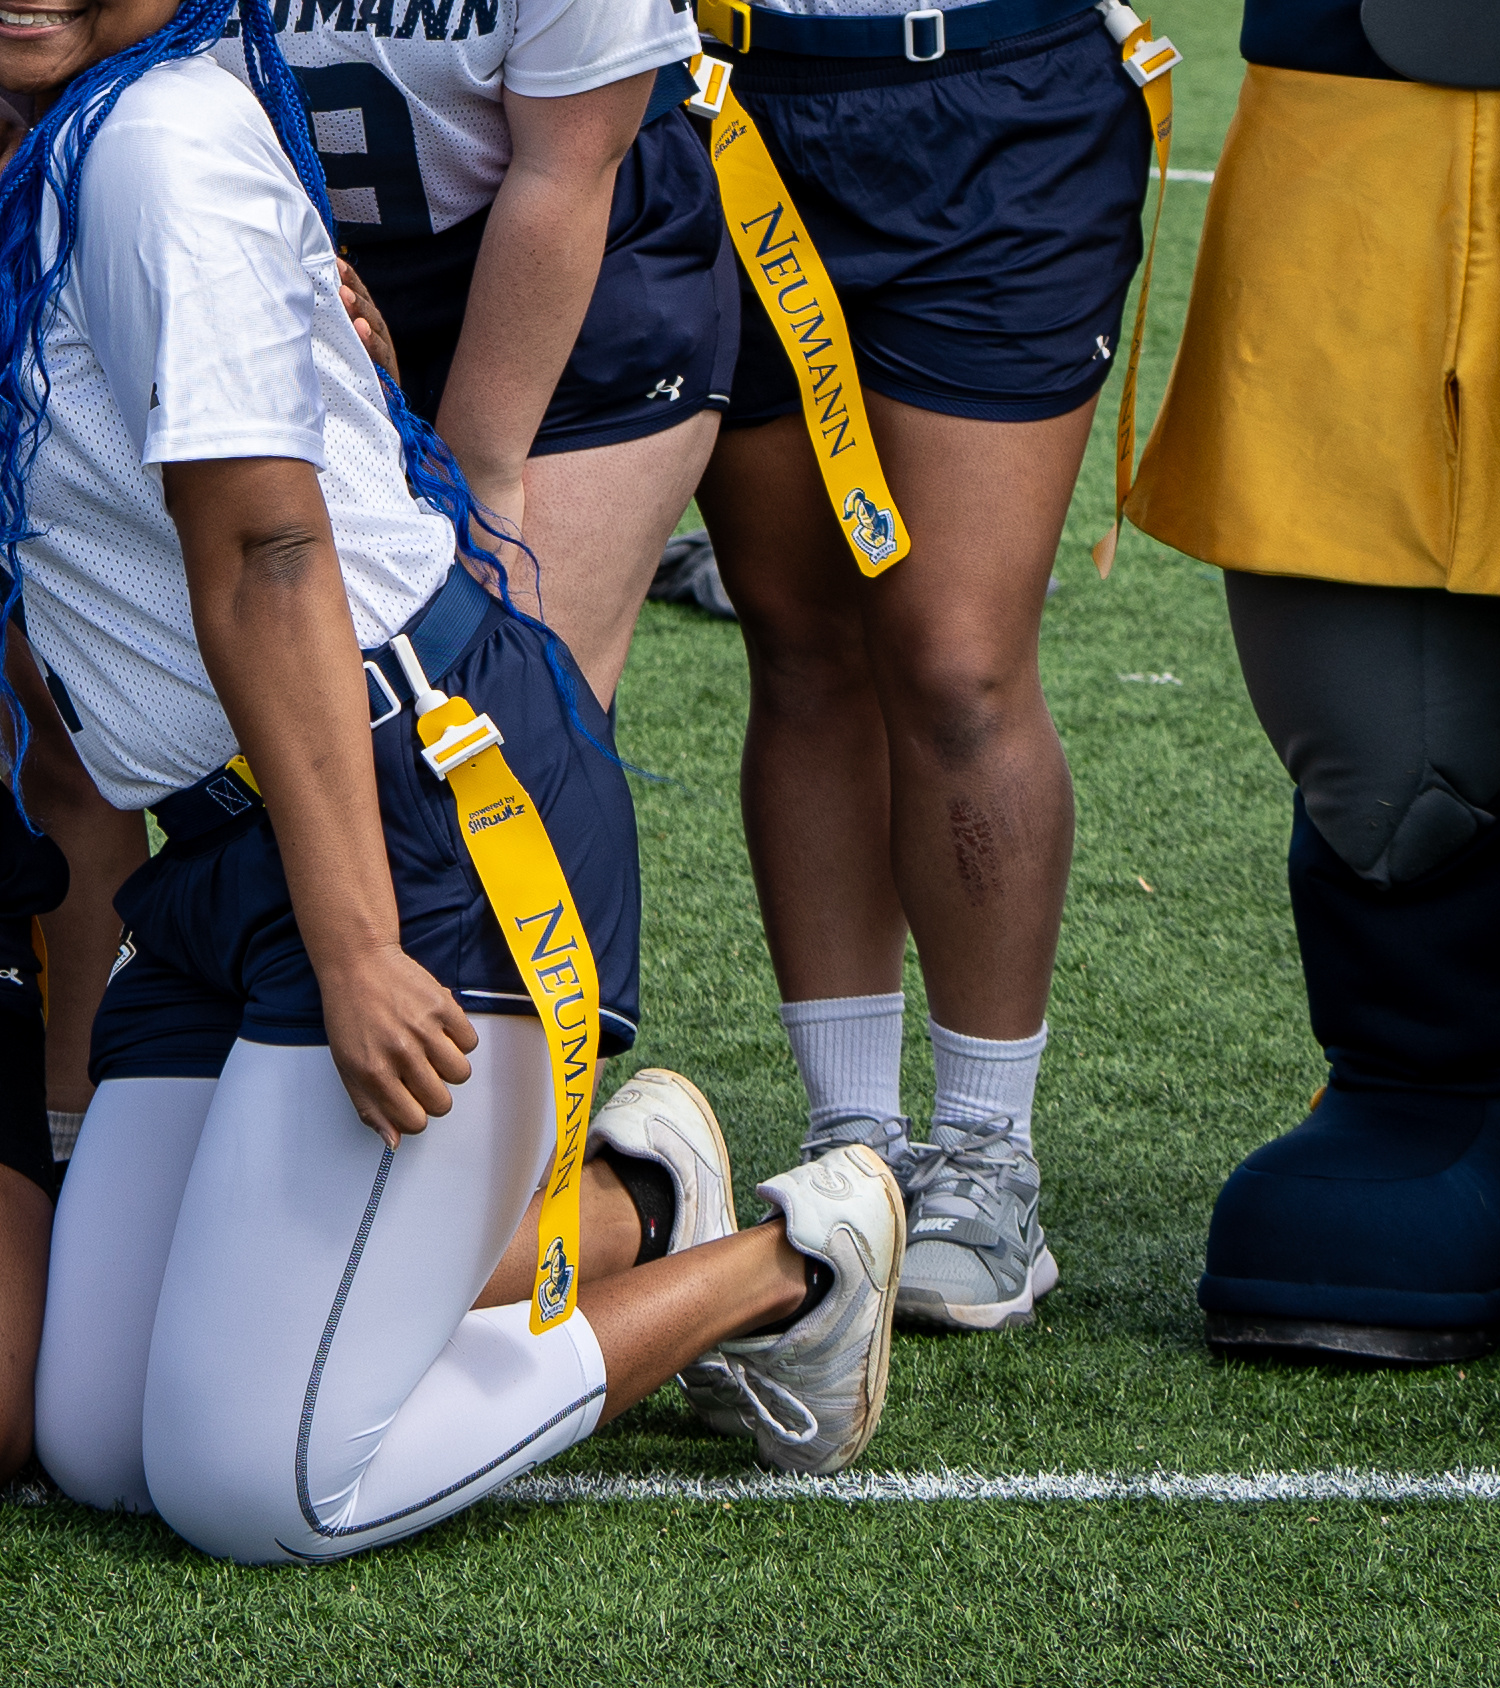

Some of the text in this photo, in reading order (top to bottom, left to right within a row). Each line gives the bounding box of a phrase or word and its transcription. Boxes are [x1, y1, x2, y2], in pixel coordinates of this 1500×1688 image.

[740, 201, 857, 459] NEUMANN
[469, 795, 515, 819] powered by
[514, 899, 588, 1199] NEUMANN
[912, 1218, 959, 1234] NIKE
